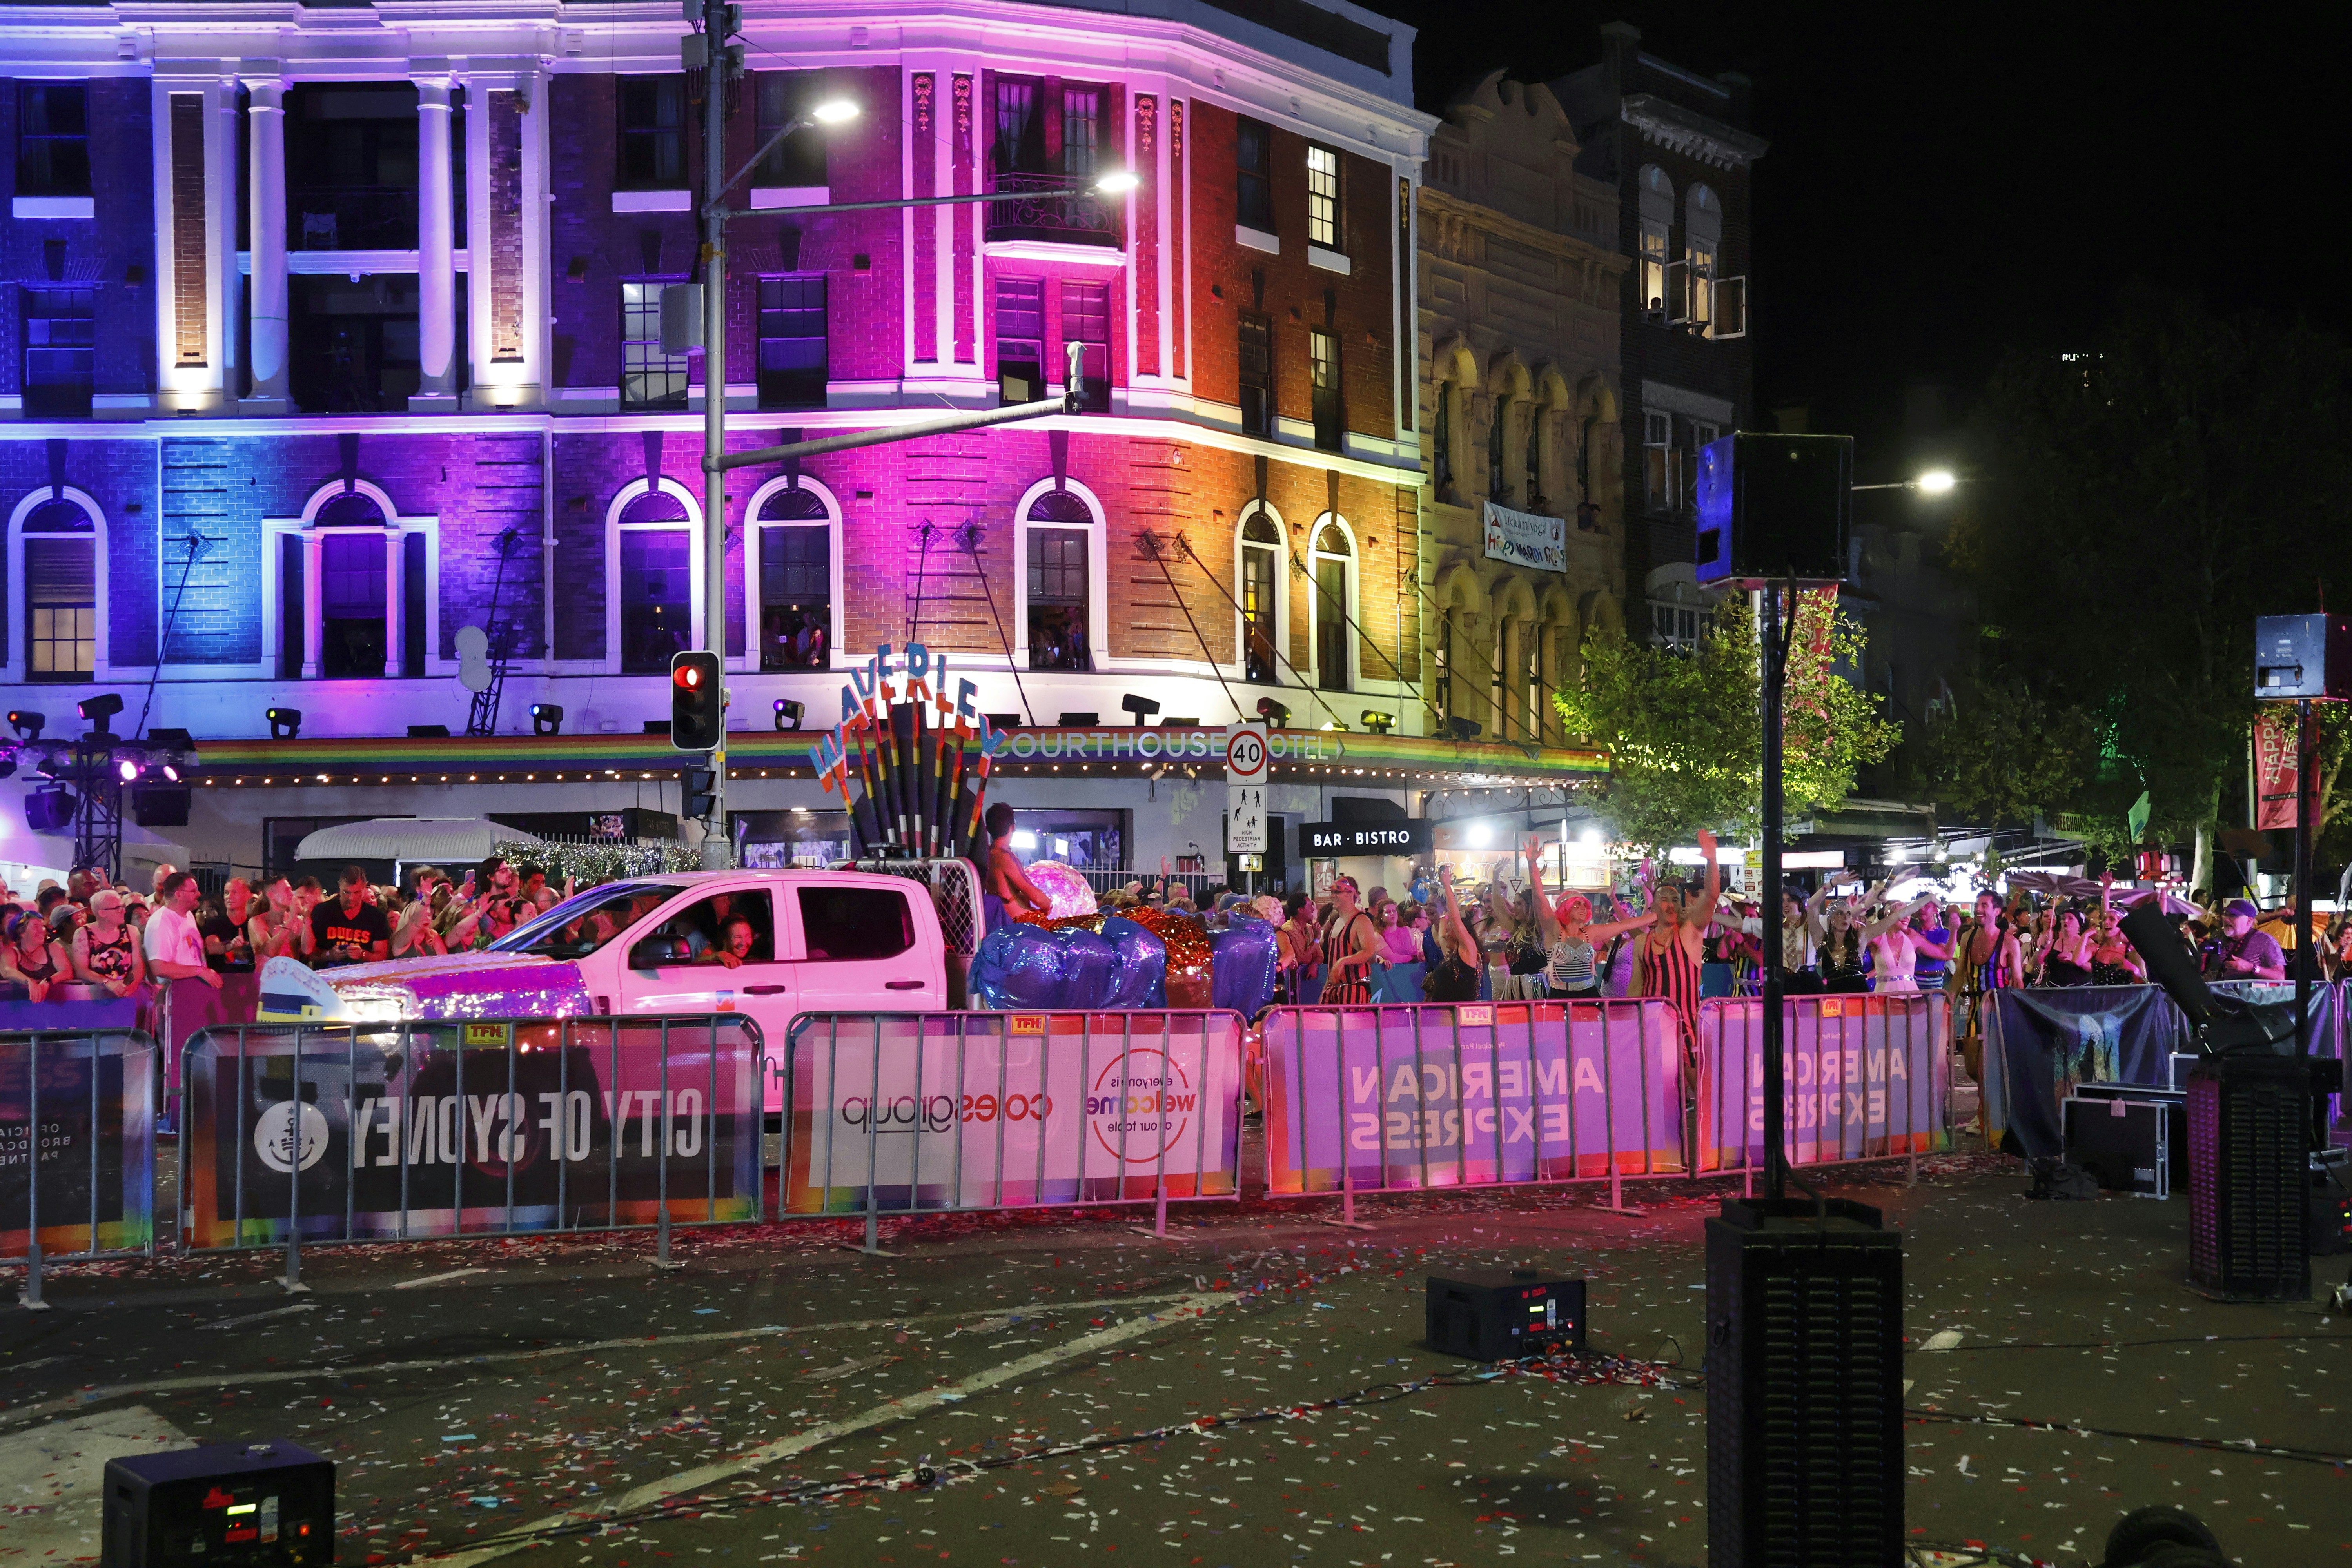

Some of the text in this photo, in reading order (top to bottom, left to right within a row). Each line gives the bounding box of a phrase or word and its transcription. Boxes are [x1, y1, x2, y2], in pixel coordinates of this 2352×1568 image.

[809, 643, 1008, 793] WAVERLEY
[992, 732, 1328, 760] OURTHOUSE OTEL
[1233, 743, 1260, 763] 40
[1314, 830, 1410, 847] BAR BISTRO
[1316, 873, 1332, 886] $15
[1464, 1009, 1486, 1018] TFH
[1016, 1018, 1039, 1028] TFH
[470, 1025, 501, 1037] TFH
